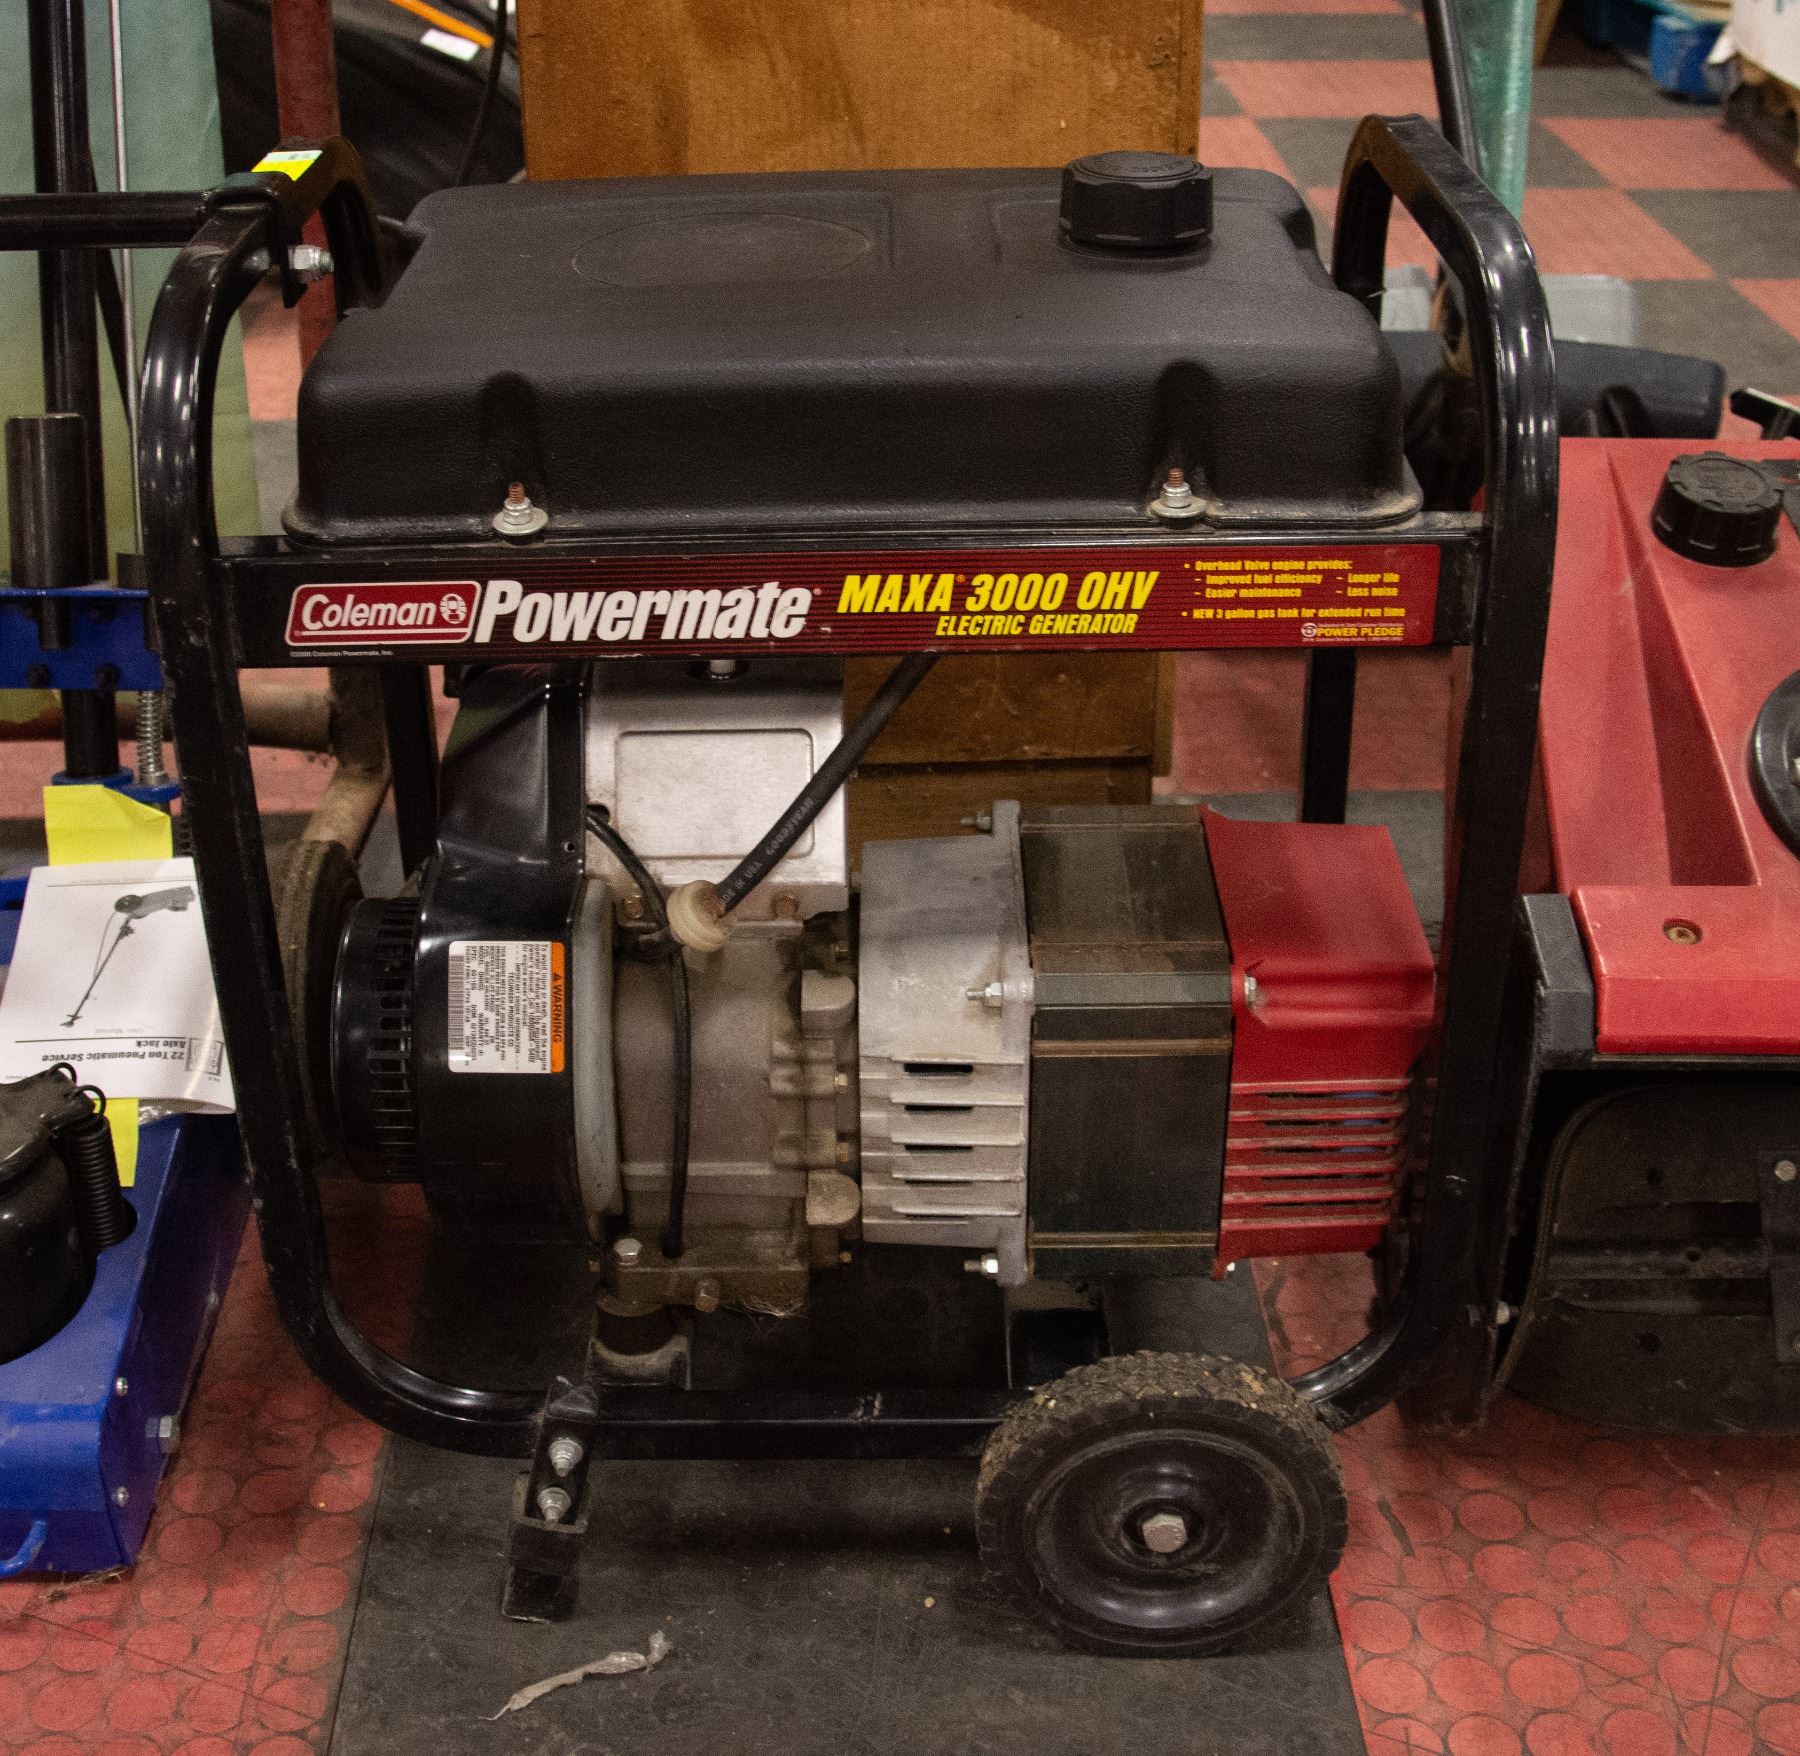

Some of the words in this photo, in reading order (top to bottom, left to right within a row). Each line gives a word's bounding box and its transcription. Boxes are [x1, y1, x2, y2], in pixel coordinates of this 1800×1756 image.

[1195, 561, 1242, 571] Overhead
[1244, 560, 1270, 570] Valve
[1272, 561, 1305, 571] engine
[1206, 574, 1252, 585] Improved
[1254, 574, 1273, 584] fuel
[1274, 573, 1323, 584] efficiency
[1347, 573, 1381, 583] Longer
[1383, 572, 1400, 583] life
[965, 573, 1069, 612] 3000
[1076, 571, 1161, 611] OHV
[1205, 588, 1237, 598] Easier
[1239, 588, 1302, 598] maintenance
[1347, 586, 1369, 597] Less
[1371, 587, 1399, 596] noise
[301, 594, 437, 631] Coleman
[474, 580, 812, 643] Powermate
[1193, 609, 1214, 619] NEW
[1216, 609, 1223, 619] 3
[1224, 609, 1255, 619] gallon
[1257, 609, 1275, 619] gas
[1277, 608, 1299, 618] tank
[1301, 608, 1317, 618] for
[1318, 608, 1363, 617] extended
[1364, 608, 1382, 617] run
[1384, 607, 1406, 617] time
[935, 614, 1025, 636] ELECTRIC
[1028, 613, 1139, 635] GENERATOR
[1317, 627, 1358, 636] POWER
[1361, 627, 1405, 636] PLEDGE
[540, 973, 548, 989] injury
[553, 984, 562, 1042] WARNING
[136, 1040, 158, 1048] Jack
[42, 1052, 83, 1062] Service
[86, 1051, 145, 1061] Pneumatic
[149, 1051, 168, 1060] Ton
[171, 1051, 185, 1060] 22
[540, 1050, 548, 1071] engine
